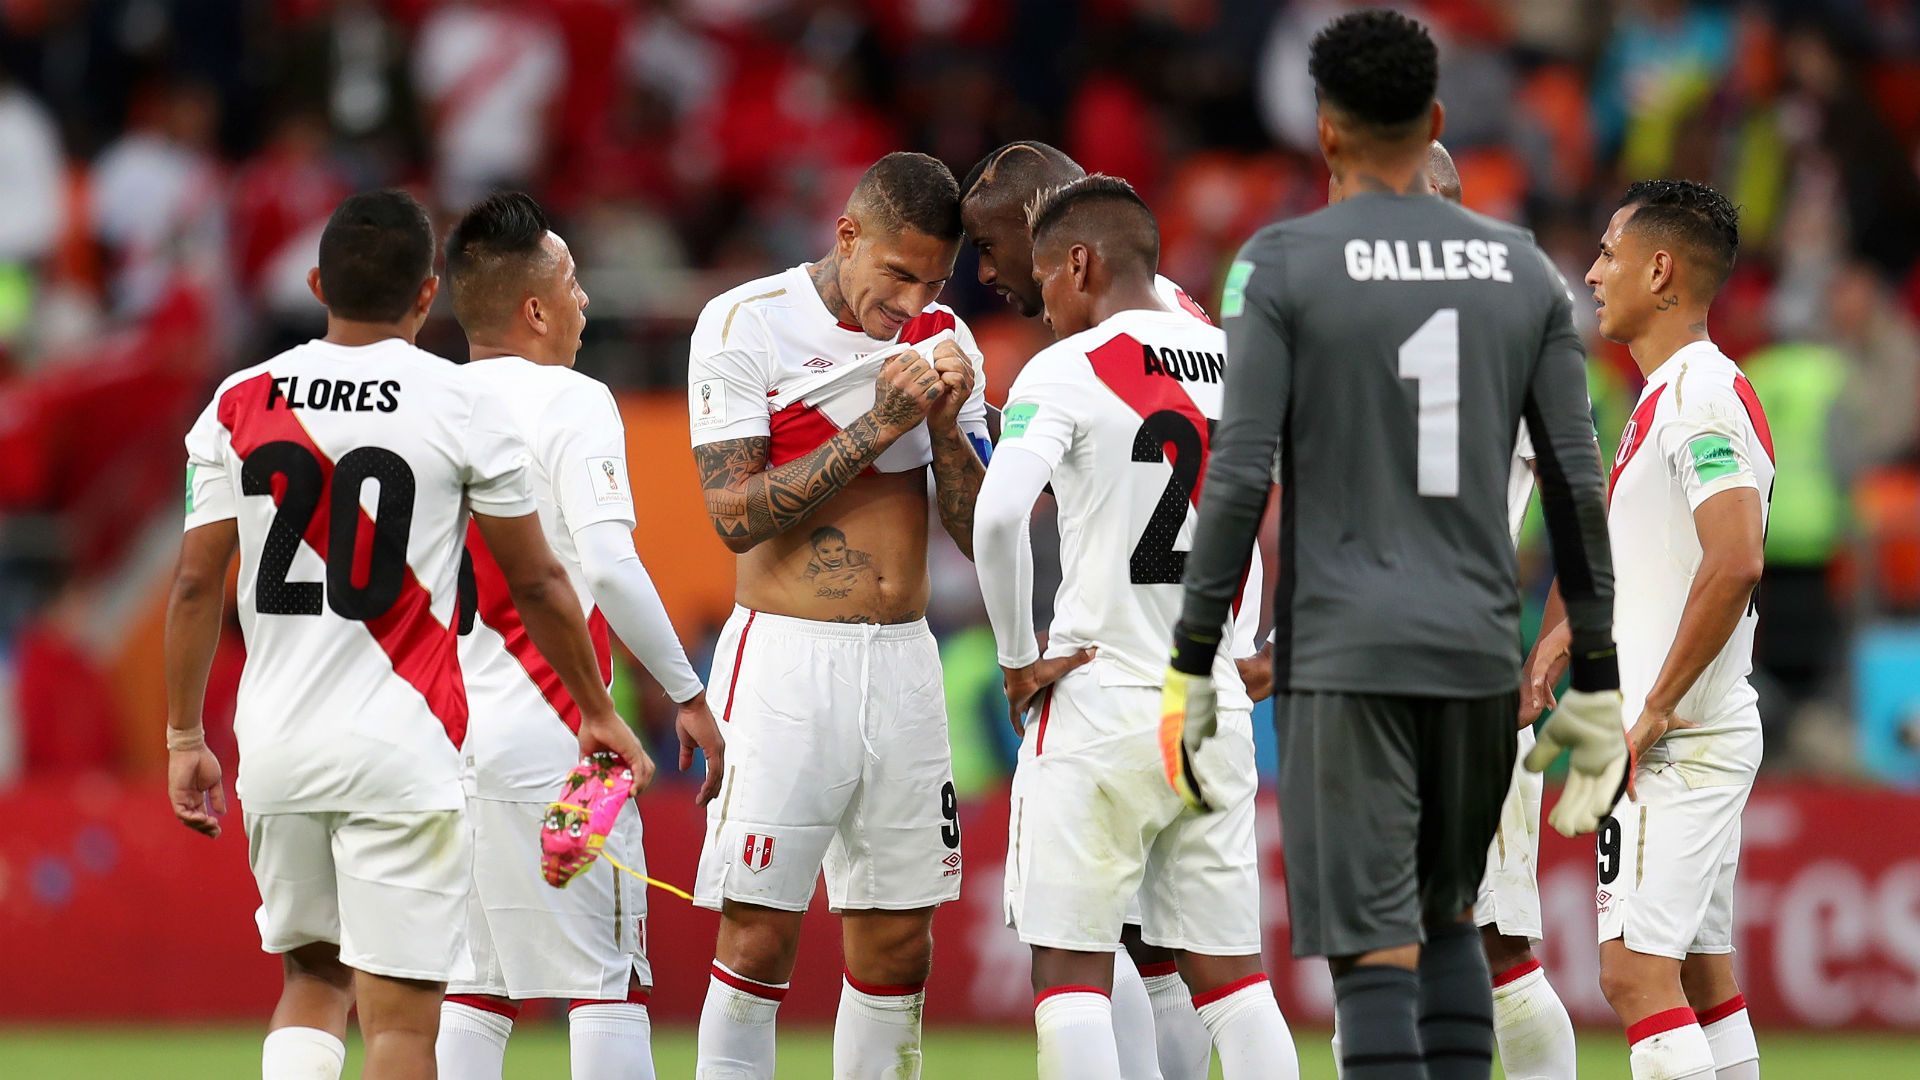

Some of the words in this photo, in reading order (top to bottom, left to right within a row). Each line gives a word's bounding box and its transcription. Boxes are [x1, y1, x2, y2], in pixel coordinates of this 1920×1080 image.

[1344, 238, 1513, 283] GALLESE
[266, 376, 401, 413] FLORES
[1398, 308, 1460, 497] 1
[241, 441, 415, 621] 20
[1131, 410, 1218, 584] 2
[941, 781, 960, 849] 9
[1597, 816, 1621, 885] 9
